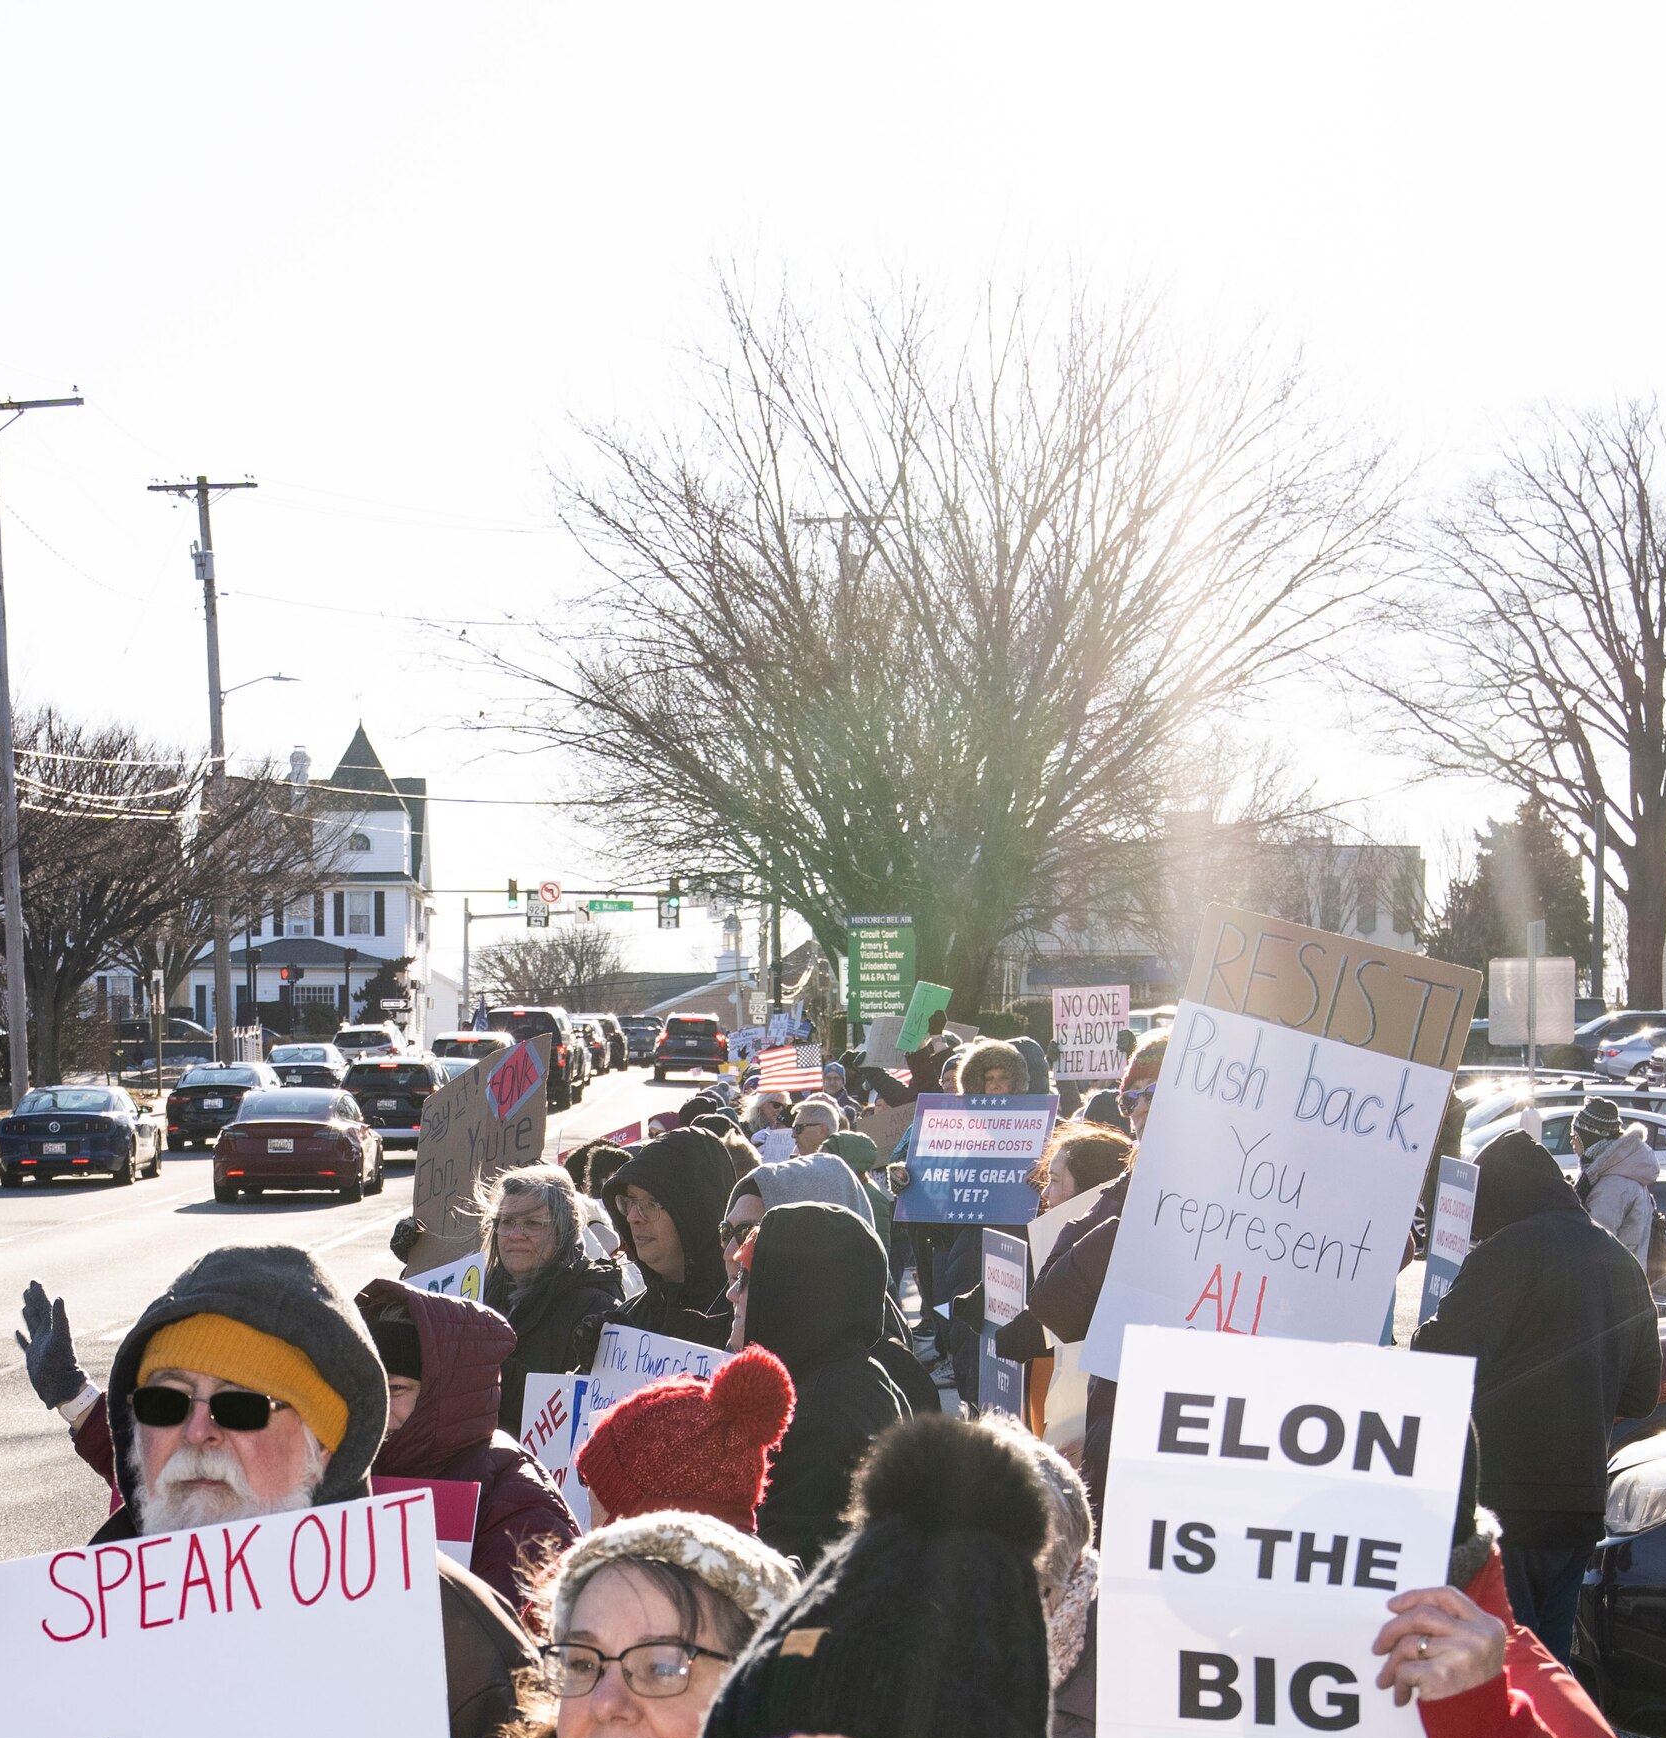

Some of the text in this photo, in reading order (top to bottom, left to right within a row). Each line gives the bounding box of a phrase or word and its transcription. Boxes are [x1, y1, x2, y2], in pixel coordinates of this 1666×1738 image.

[528, 905, 546, 915] 924
[851, 916, 885, 924] HISTORIC
[881, 930, 898, 938] Court
[885, 951, 904, 959] Center
[886, 973, 900, 981] Trail
[860, 990, 882, 998] District
[1061, 993, 1120, 1017] NO ONE
[751, 1005, 766, 1013] 924
[883, 1002, 905, 1011] County
[1055, 1023, 1068, 1045] IS
[1057, 1049, 1124, 1073] THE LAW
[1175, 1009, 1420, 1152] Push back.
[420, 1101, 451, 1143] Say
[928, 1118, 1042, 1131] CHAOS, CULTURE WARS
[928, 1140, 1032, 1151] AND HIGHER COSTS
[921, 1168, 1027, 1184] ARE WE GREAT
[1230, 1125, 1306, 1209] You
[953, 1189, 989, 1202] YET?
[1154, 1188, 1372, 1281] represent
[603, 1331, 628, 1372] The
[635, 1334, 670, 1377] Power
[697, 1355, 711, 1379] Th
[522, 1388, 569, 1457] THE
[1157, 1392, 1421, 1478] ELON
[1149, 1519, 1402, 1591] IS THE
[42, 1524, 264, 1643] SPEAK
[288, 1493, 425, 1607] OUT
[1178, 1650, 1360, 1731] BIG
